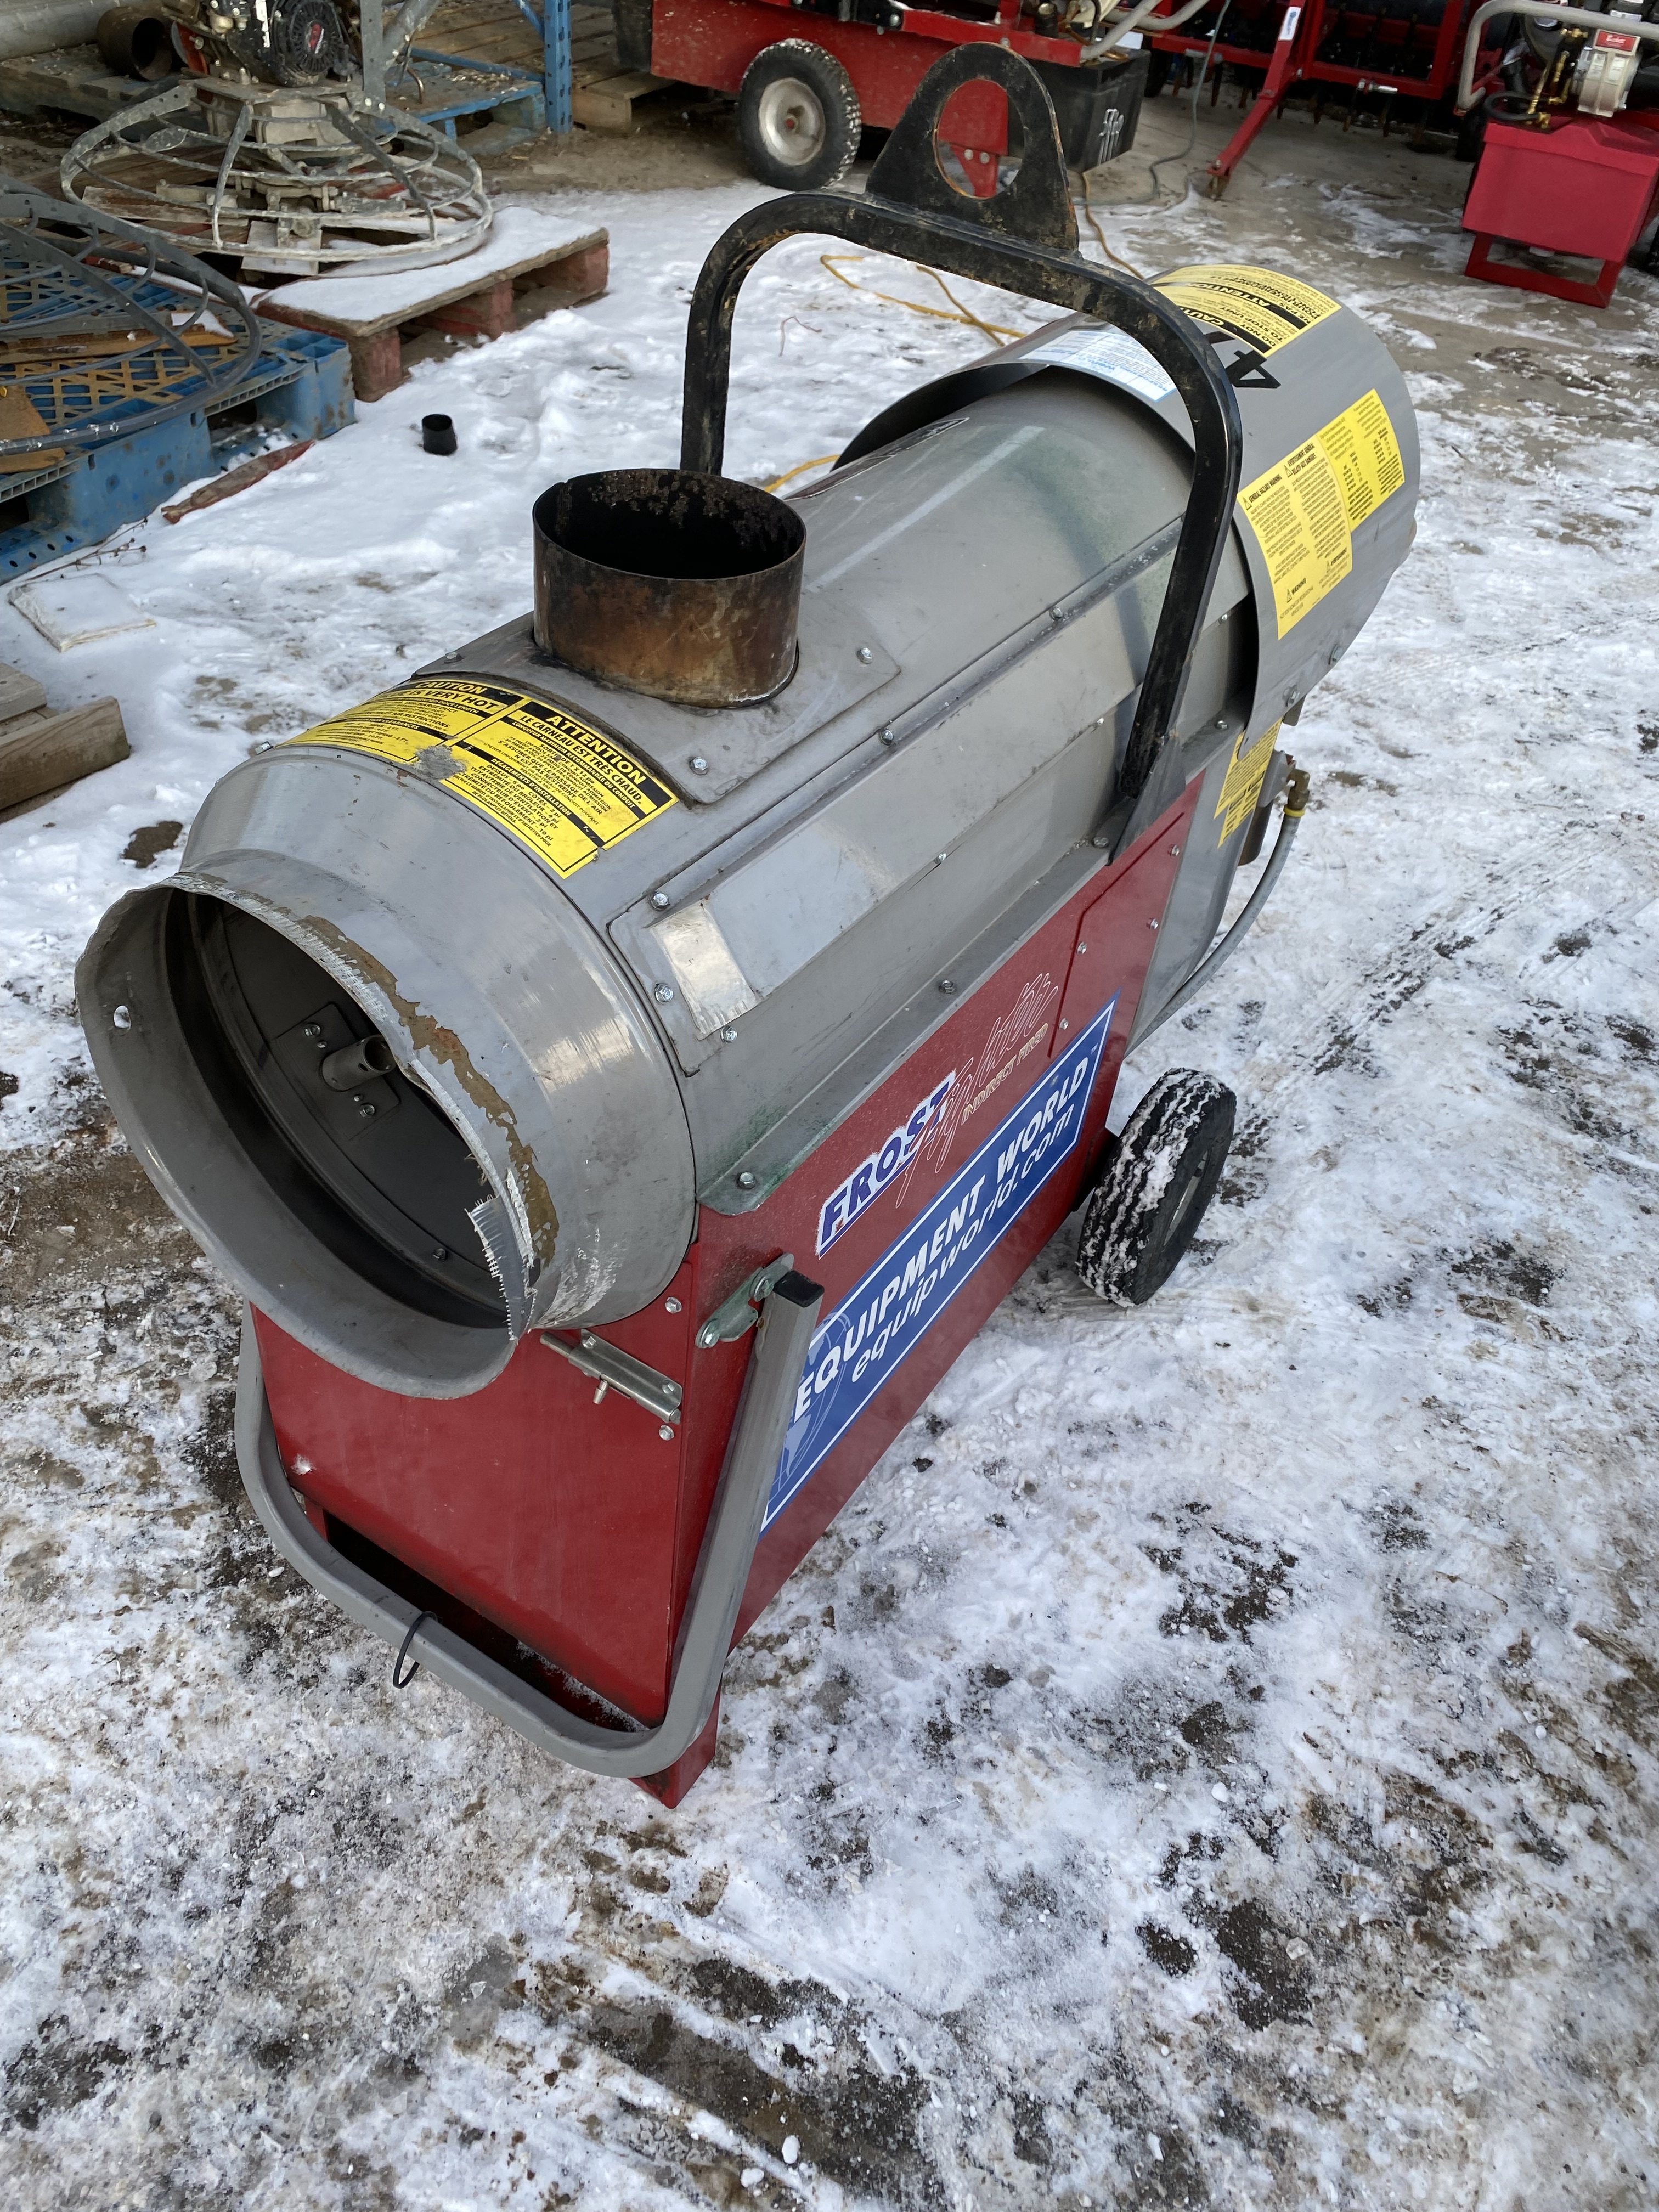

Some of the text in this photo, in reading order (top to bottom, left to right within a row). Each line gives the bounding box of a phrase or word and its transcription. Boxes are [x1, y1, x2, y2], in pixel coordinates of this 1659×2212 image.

[1180, 307, 1223, 325] CAUT
[1188, 282, 1271, 306] ATTENTION
[1278, 302, 1311, 324] NE PAS
[1292, 301, 1318, 319] POUR
[1219, 307, 1282, 342] TO STOP UNIT
[1238, 323, 1277, 346] DO NOT
[415, 682, 488, 695] CAUTION
[425, 690, 460, 699] VERY
[462, 696, 499, 710] HOT
[402, 713, 451, 727] RESTRICTIONS
[511, 721, 636, 808] LONGUEUR MAXIMUM RECOMMANDÉE DU CONDUIT
[519, 715, 644, 804] LE CARNEAU EST TRÈS CHAUD.
[531, 764, 545, 775] PAS
[533, 745, 547, 754] PIEDS
[558, 761, 579, 777] CONDUIT
[578, 776, 604, 797] ADMISSION
[539, 743, 558, 757] SORTI
[545, 715, 647, 785] ATTENTION
[470, 772, 509, 798] CONNECTEUR
[507, 797, 533, 816] D'ÉVENT
[478, 765, 511, 786] EXTRÉMITÉ
[518, 791, 545, 811] BRÛLEUR
[486, 764, 510, 779] DESSUS
[528, 791, 547, 806] CÔTÉS
[490, 758, 572, 816] DÉGAGEMENTS D'INSTALLATION
[510, 741, 525, 751] PIEDS
[524, 749, 538, 758] AVEC
[542, 760, 557, 771] PIEDS
[562, 774, 584, 791] CONDUIT
[582, 789, 608, 812] ADMISSION
[514, 739, 529, 748] PIEDS
[527, 747, 540, 755] AVEC
[546, 758, 561, 769] PIEDS
[565, 771, 587, 788] CONDUIT
[585, 787, 612, 810] ADMISSION
[530, 758, 545, 769] QUE
[550, 772, 580, 794] PASSAGE
[577, 793, 588, 802] DE
[460, 773, 486, 789] TRÉMITÉ
[494, 793, 536, 826] REFOULEMENT
[470, 766, 506, 789] TUYAUTERIE
[512, 793, 551, 823] VENTILATION
[549, 822, 558, 830] ET
[486, 800, 502, 811] AMPLES
[561, 792, 580, 808] CONDUIT
[578, 807, 599, 825] POUVANT
[539, 837, 551, 847] POUR
[961, 1023, 1048, 1125] INDIRECT FIRED
[821, 1080, 950, 1245] FROST
[794, 1173, 985, 1423] EQUIPMENT
[997, 1057, 1088, 1184] WORLD
[851, 1102, 1074, 1384] equipworld.com
